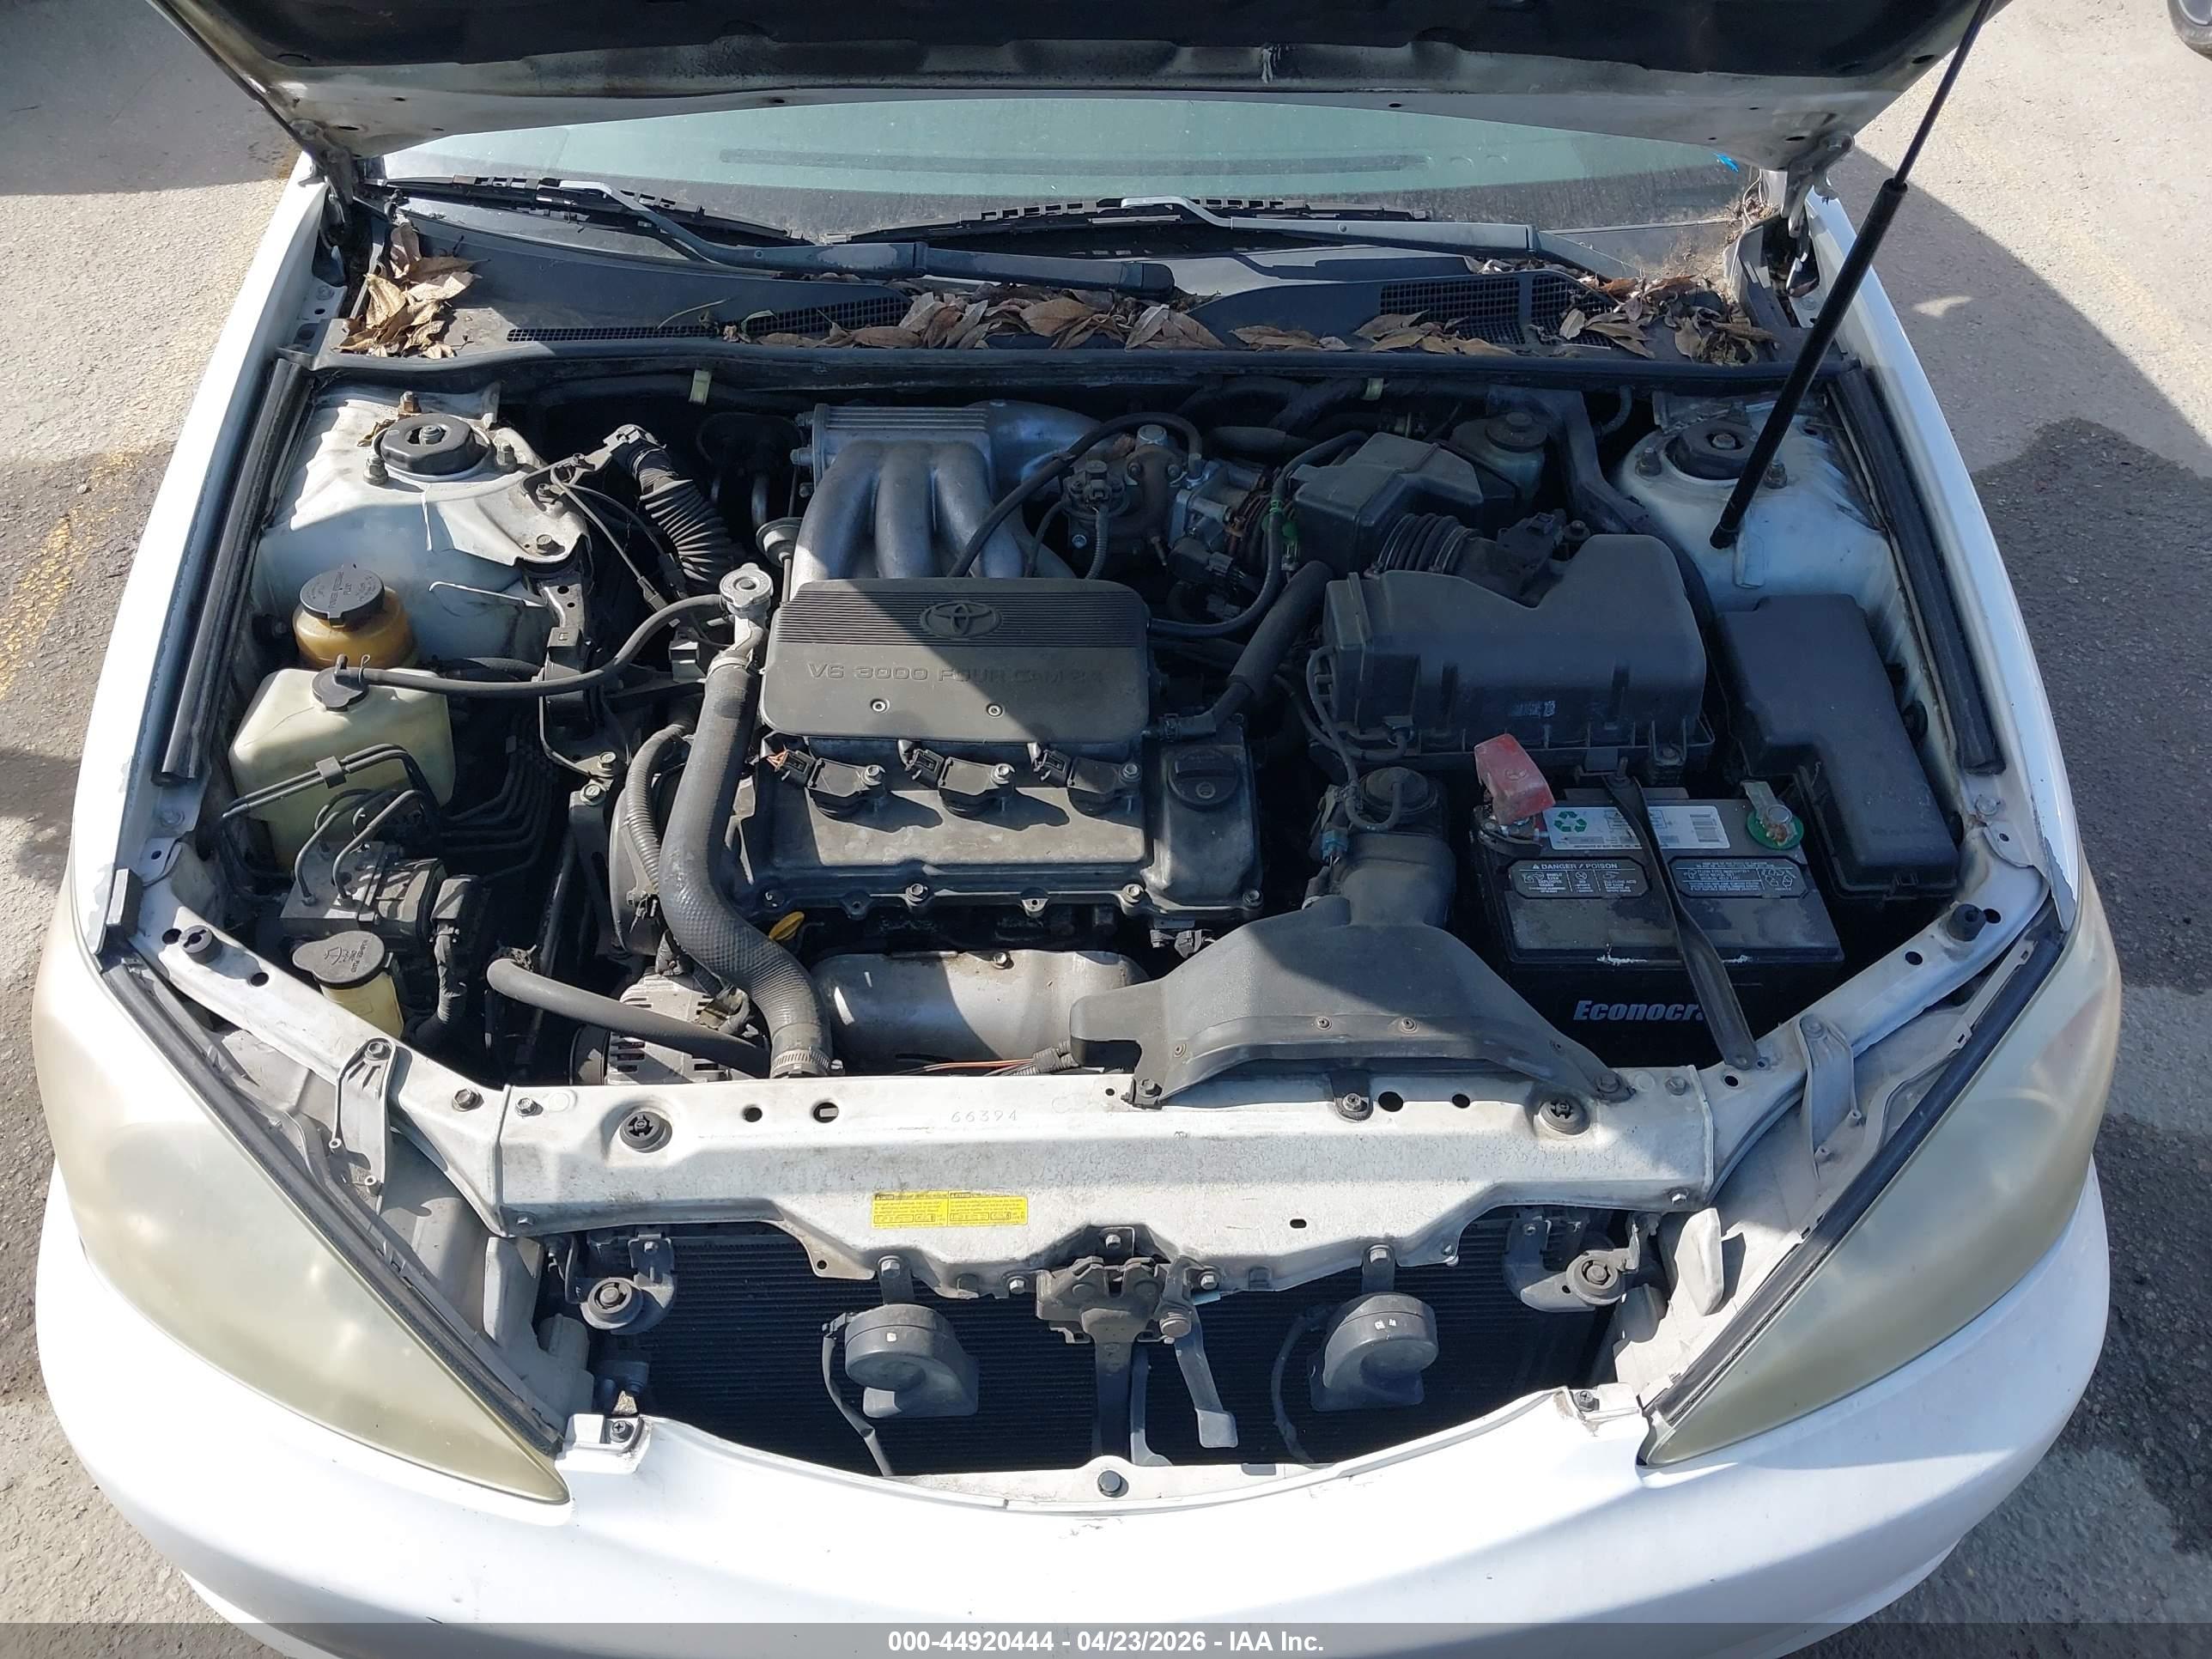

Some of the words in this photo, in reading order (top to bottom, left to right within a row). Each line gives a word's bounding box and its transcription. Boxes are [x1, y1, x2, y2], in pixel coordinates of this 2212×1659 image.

[807, 663, 845, 680] V6
[853, 665, 928, 682] 3000
[938, 666, 1006, 684] FOUR
